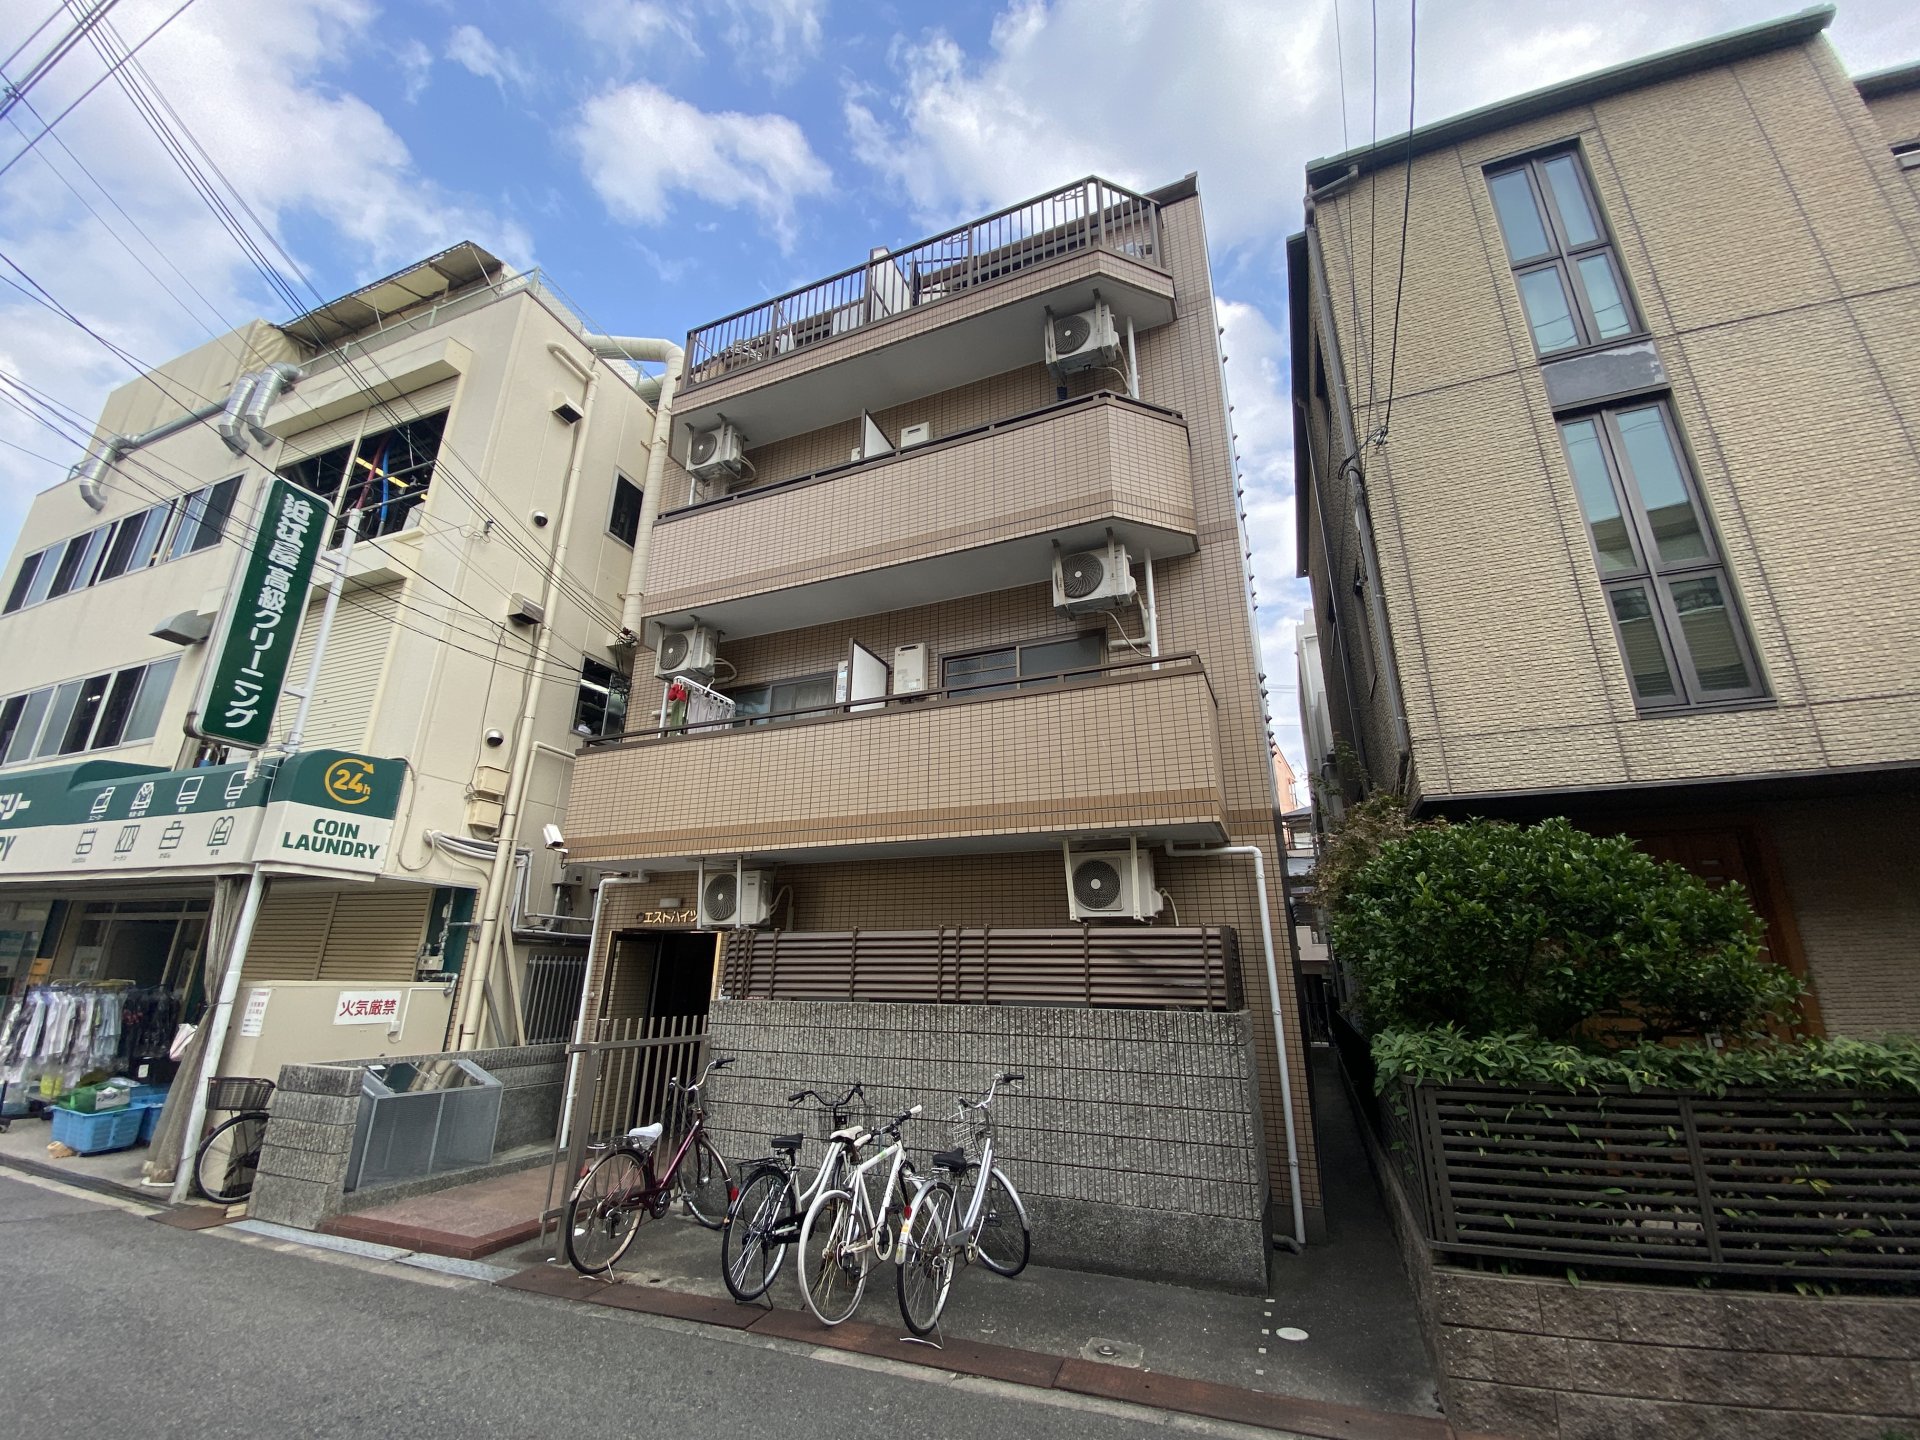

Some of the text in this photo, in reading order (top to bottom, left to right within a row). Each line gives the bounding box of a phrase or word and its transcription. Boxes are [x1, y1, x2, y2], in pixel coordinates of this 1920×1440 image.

[313, 818, 360, 841] COIN
[282, 831, 381, 861] LAUNDRY
[339, 999, 397, 1017] 火気厳禁
